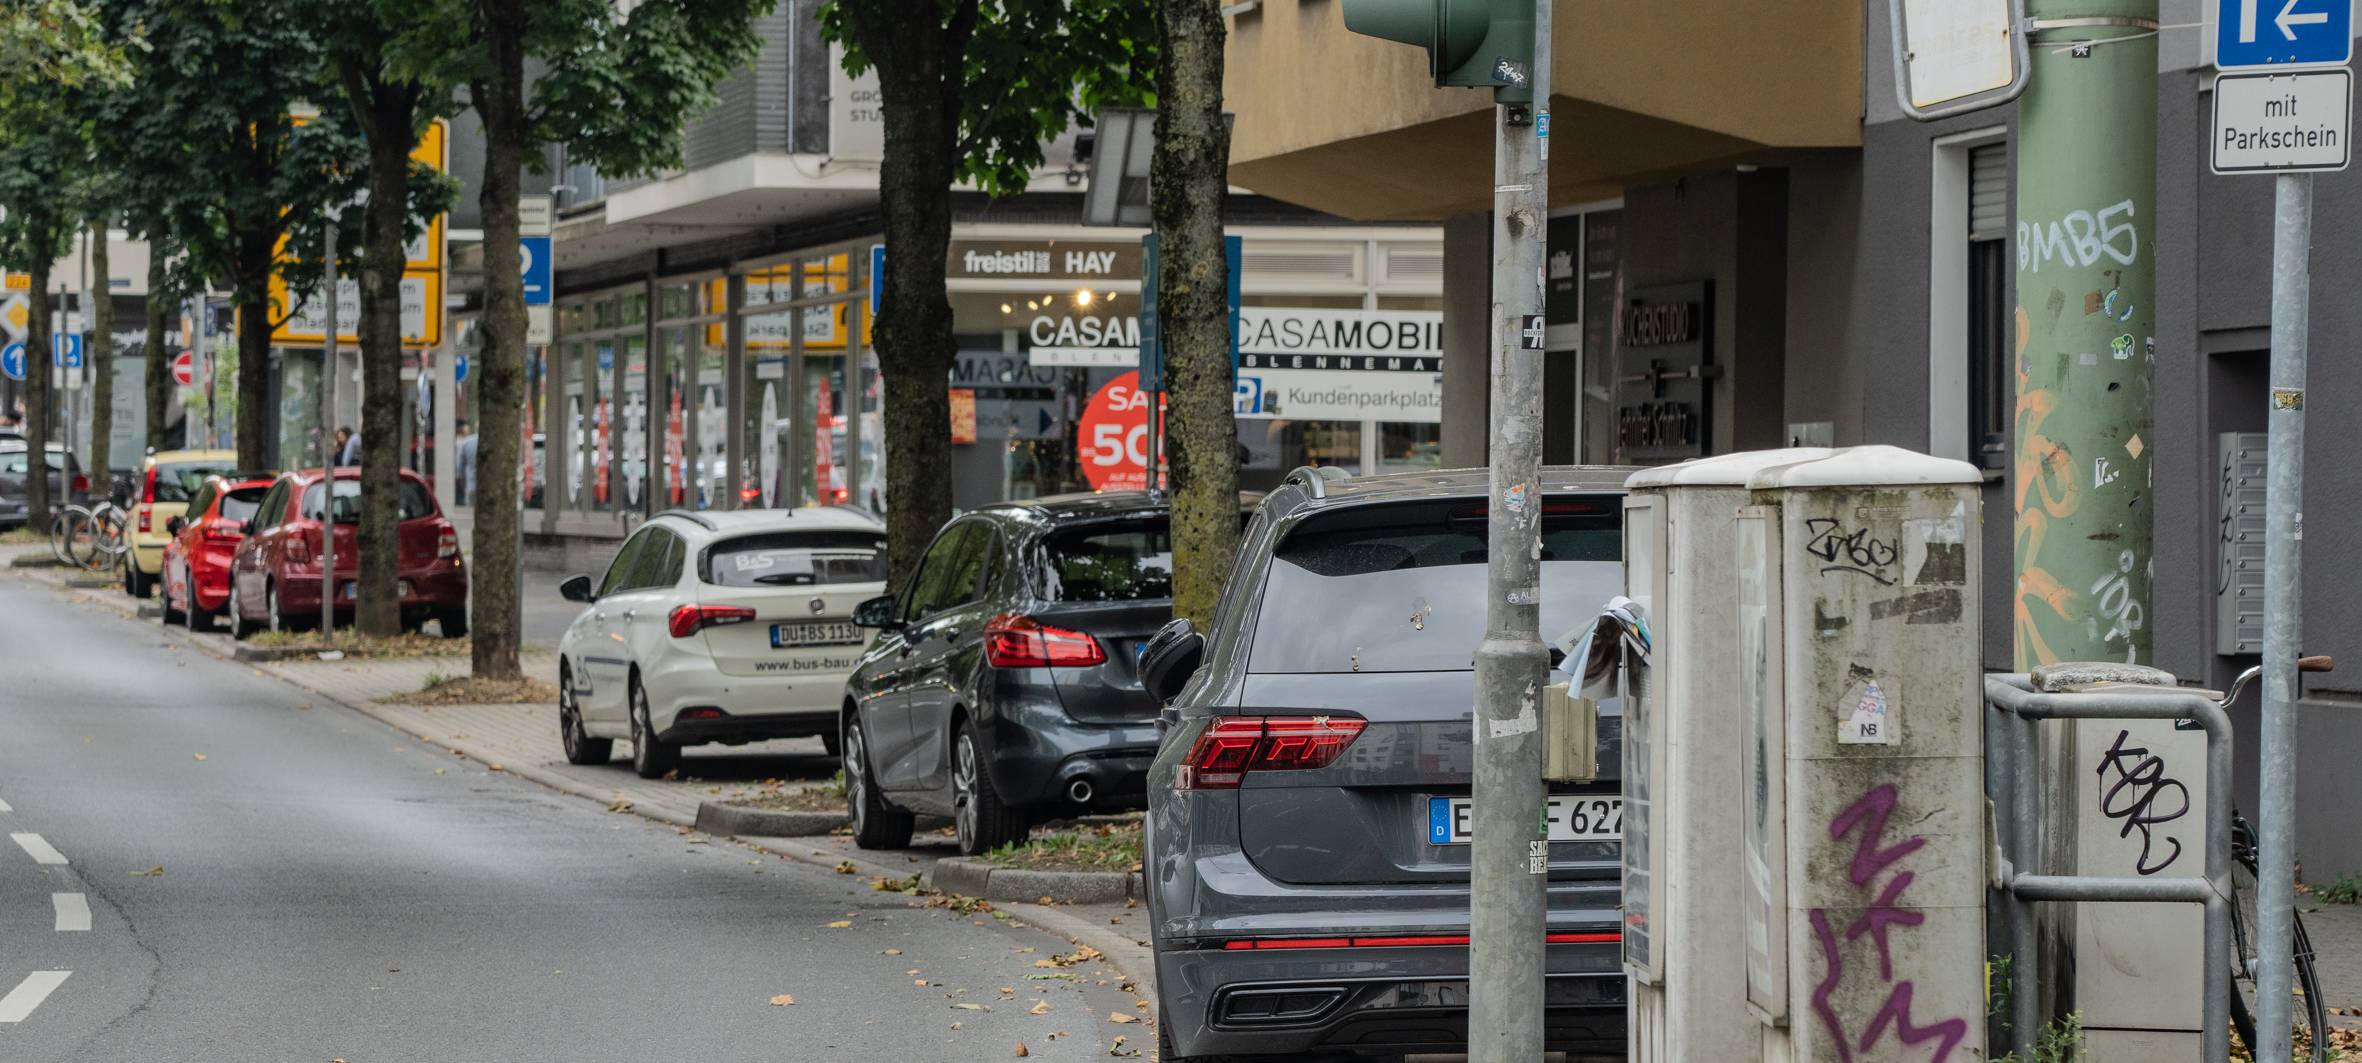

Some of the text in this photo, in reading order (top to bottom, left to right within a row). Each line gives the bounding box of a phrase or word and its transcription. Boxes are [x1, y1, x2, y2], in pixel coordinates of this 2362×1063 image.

[2265, 94, 2297, 117] mit
[2224, 124, 2337, 151] Parkschein
[964, 249, 1035, 273] freistil
[1065, 250, 1117, 273] HAY
[1107, 386, 1149, 411] SA
[1288, 387, 1443, 409] Kundenparkplatz
[781, 625, 798, 641] DU
[808, 624, 826, 641] BS
[1436, 825, 1445, 837] D
